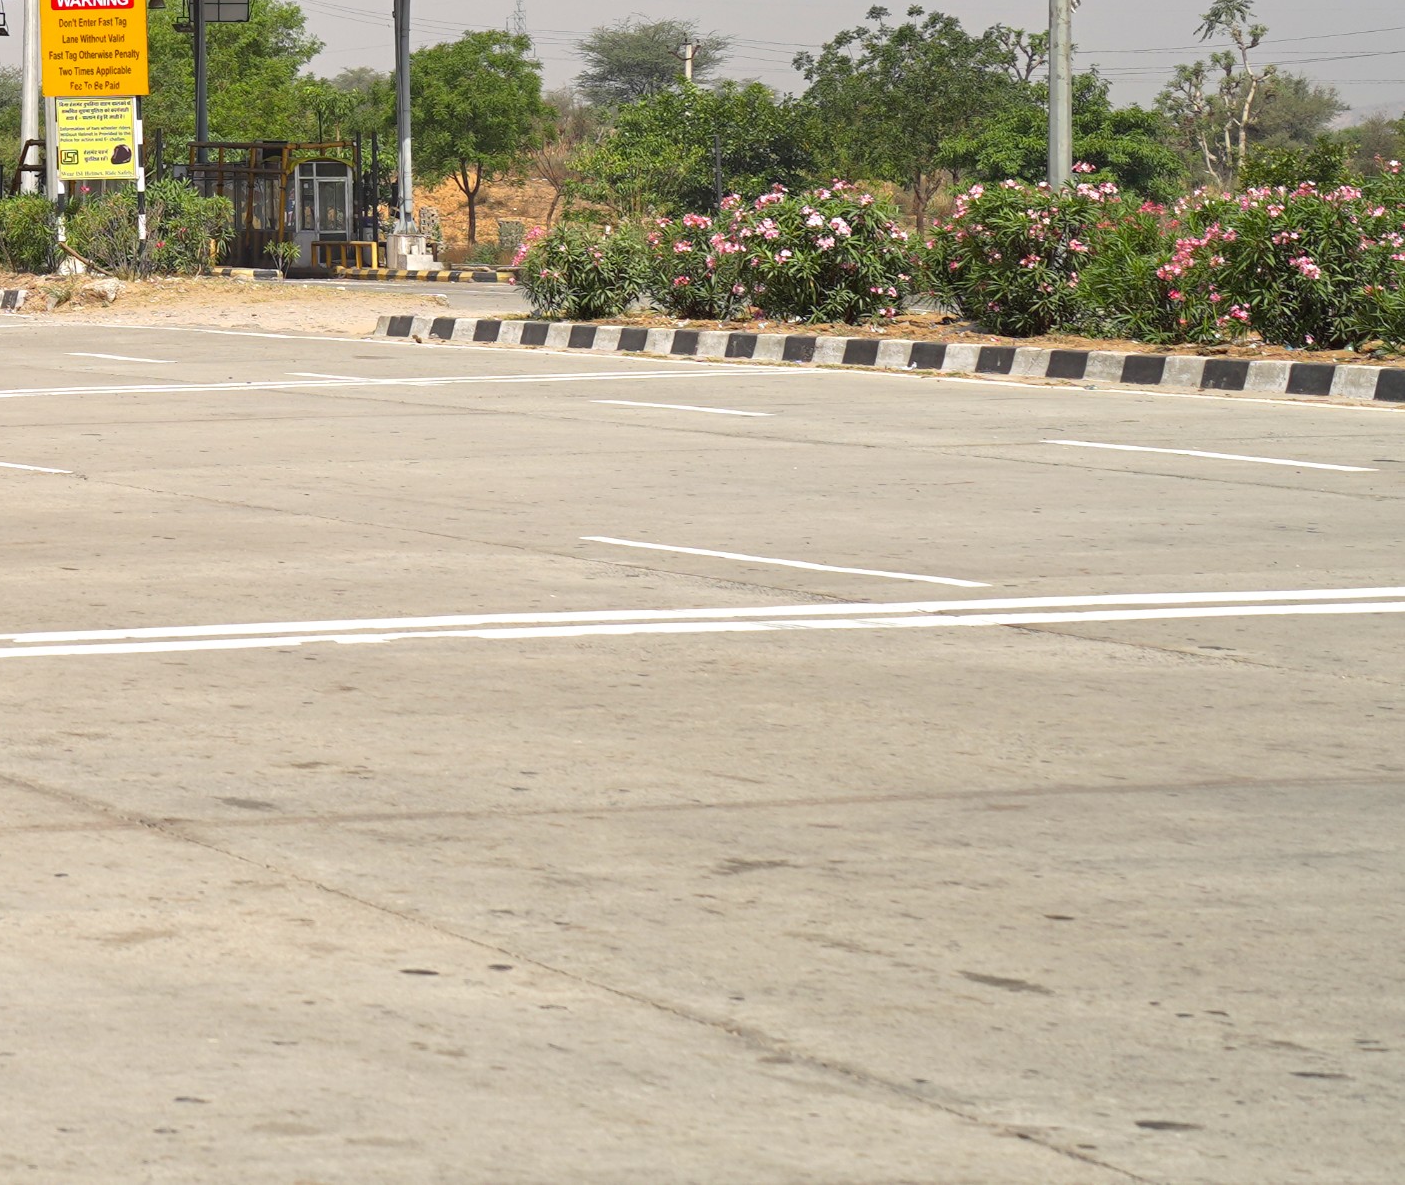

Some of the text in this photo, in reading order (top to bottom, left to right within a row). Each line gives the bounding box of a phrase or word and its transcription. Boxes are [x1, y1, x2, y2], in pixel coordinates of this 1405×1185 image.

[59, 17, 127, 28] Don't Enter Fast Tag
[62, 34, 125, 43] Lane Without Valid
[49, 49, 139, 61] Fast Tag Otherwise Penalty
[59, 66, 131, 77] Two Times Applicable
[94, 81, 103, 90] Be
[105, 81, 120, 89] Paid
